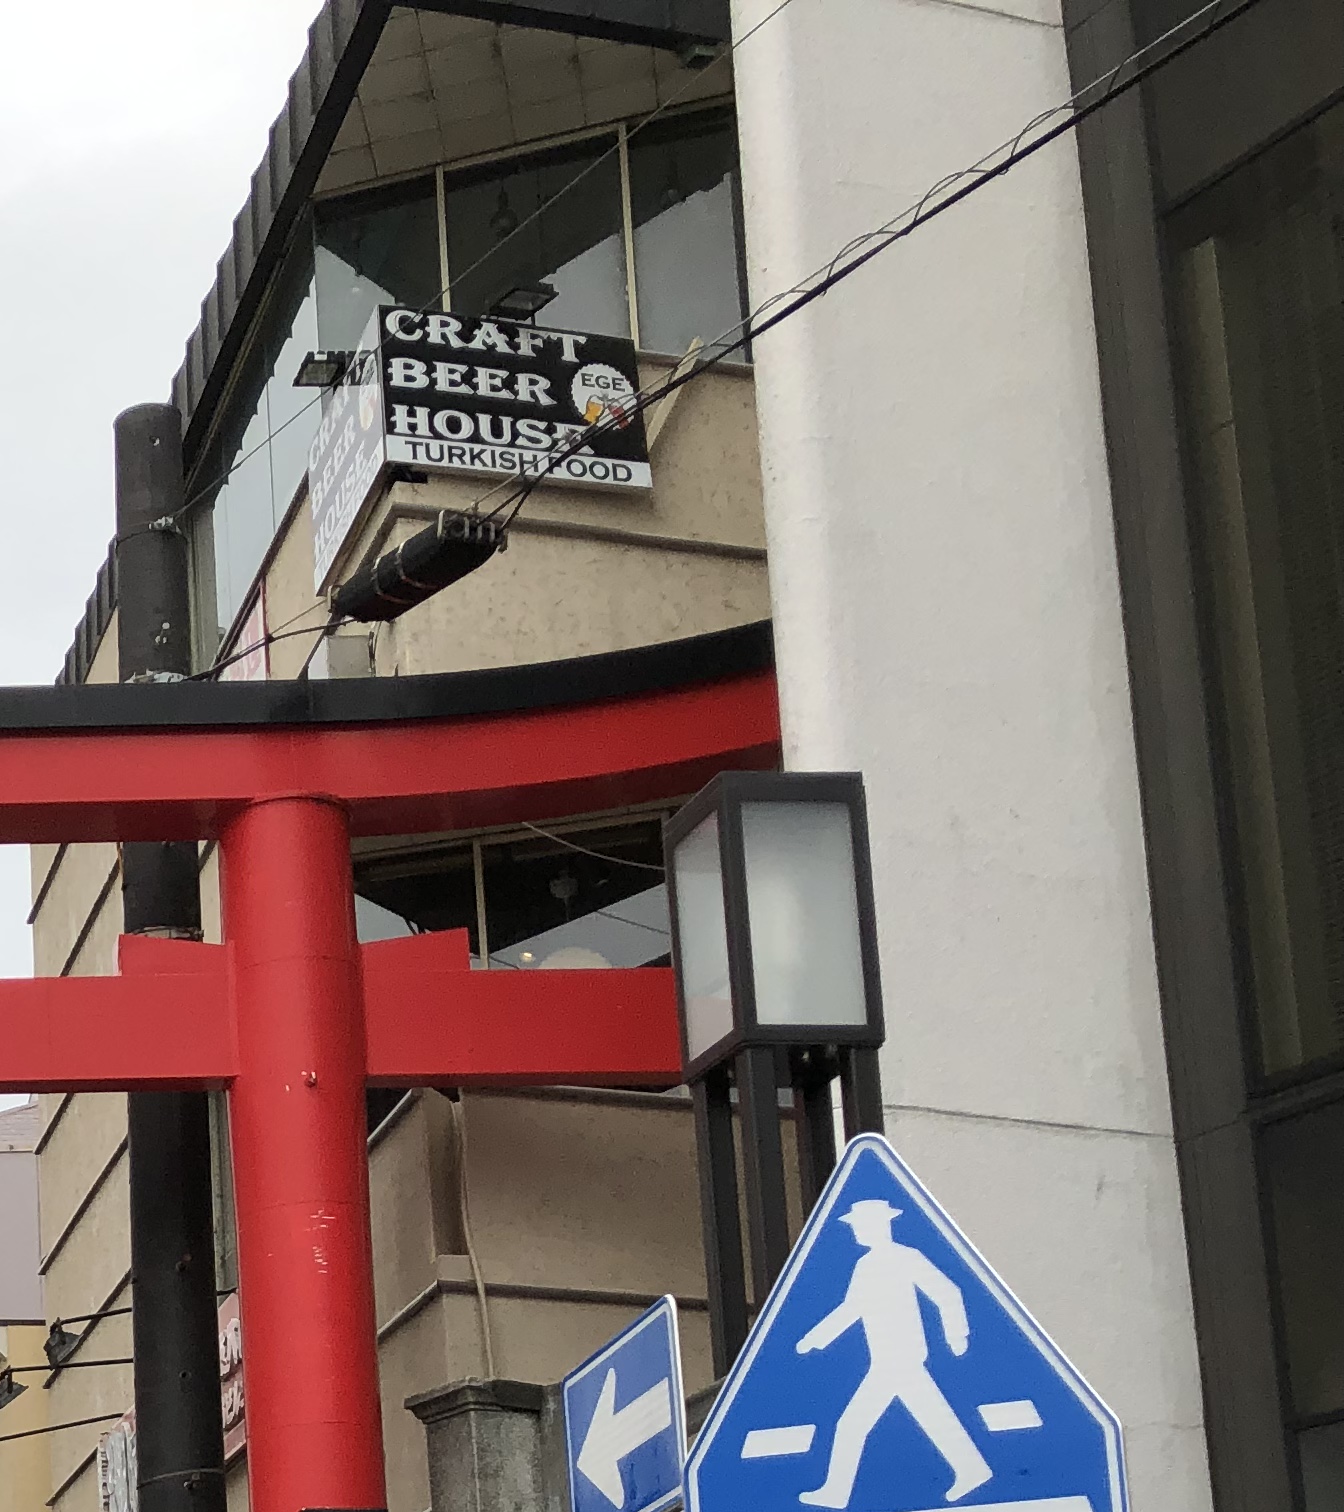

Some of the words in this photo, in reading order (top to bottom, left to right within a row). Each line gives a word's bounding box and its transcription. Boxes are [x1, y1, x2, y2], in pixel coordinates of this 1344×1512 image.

[385, 309, 587, 363] CRAFT
[389, 358, 556, 405] BEER
[580, 372, 626, 392] EGE
[390, 404, 595, 455] HOUSE
[404, 440, 539, 474] TURKISH
[549, 459, 633, 483] FOOD
